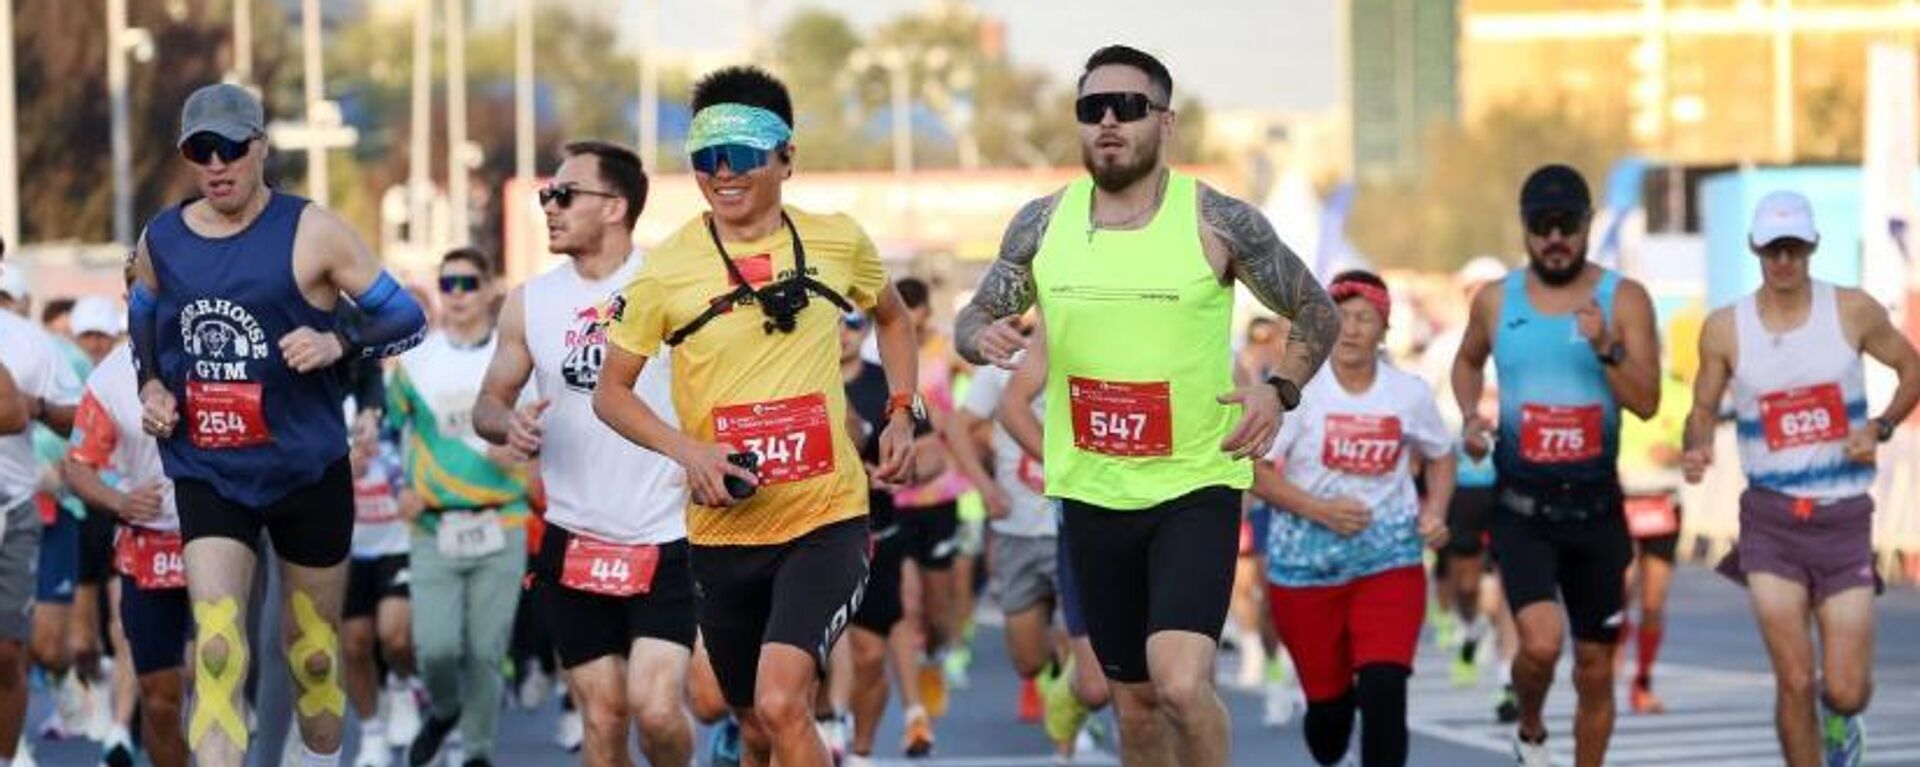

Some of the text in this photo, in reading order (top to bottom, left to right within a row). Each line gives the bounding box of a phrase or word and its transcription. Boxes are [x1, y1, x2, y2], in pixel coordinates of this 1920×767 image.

[195, 361, 248, 380] GYM
[197, 411, 246, 434] 254
[1090, 411, 1147, 440] 547
[742, 431, 806, 465] 347
[1328, 438, 1398, 461] 14777
[1539, 427, 1584, 450] 775
[590, 558, 629, 581] 44
